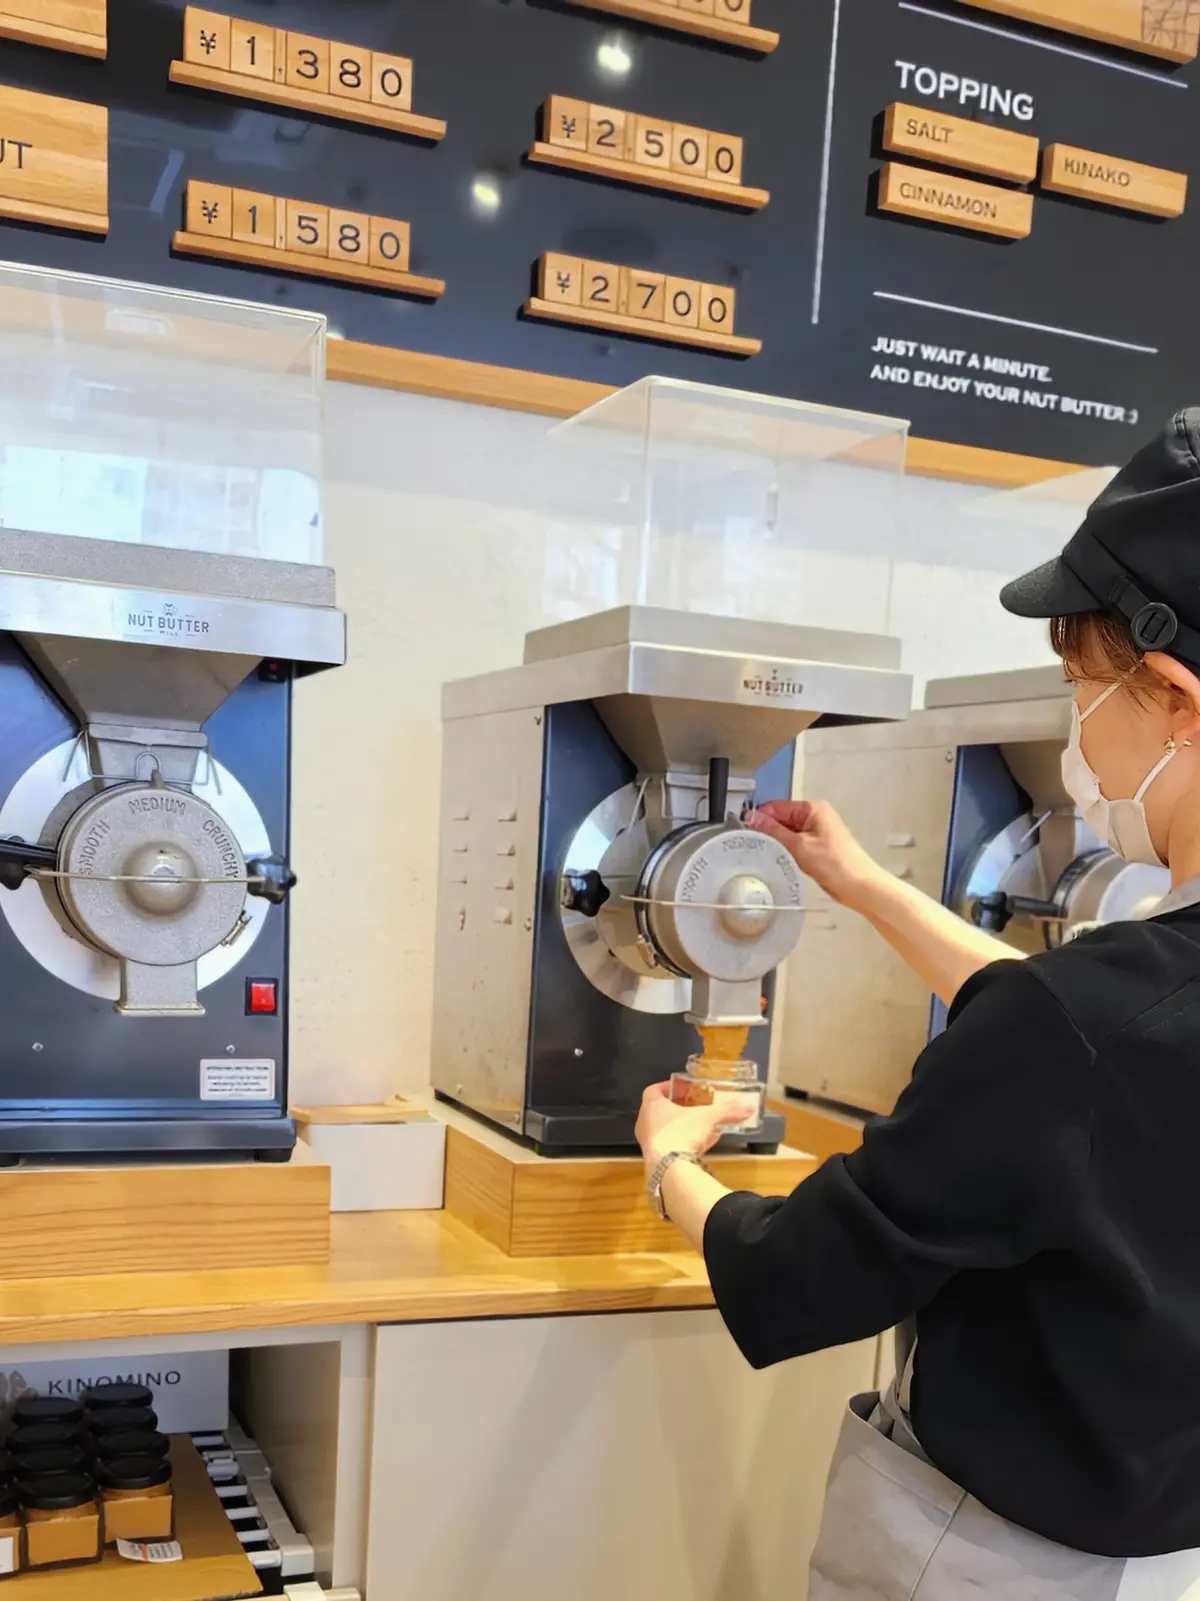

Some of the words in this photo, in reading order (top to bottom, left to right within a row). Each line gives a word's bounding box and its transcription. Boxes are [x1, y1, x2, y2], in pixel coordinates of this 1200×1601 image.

[894, 59, 1035, 121] TOPPING
[905, 118, 954, 144] SALT
[1063, 156, 1132, 188] KINAKO
[899, 181, 998, 219] CINNAMON
[871, 336, 919, 358] JUST
[920, 343, 968, 366] WAIT
[966, 352, 981, 370] A
[870, 364, 911, 384] AND
[913, 370, 972, 394] ENJOY
[973, 380, 1020, 404] YOUR
[1021, 389, 1060, 411] NUT
[1060, 396, 1126, 422] BUTTER
[127, 612, 155, 628] NUT
[157, 616, 210, 634] BUTTER
[127, 796, 188, 817] MEDIUM
[79, 818, 112, 876] SMOOTH
[202, 818, 242, 878] CRUNCHY
